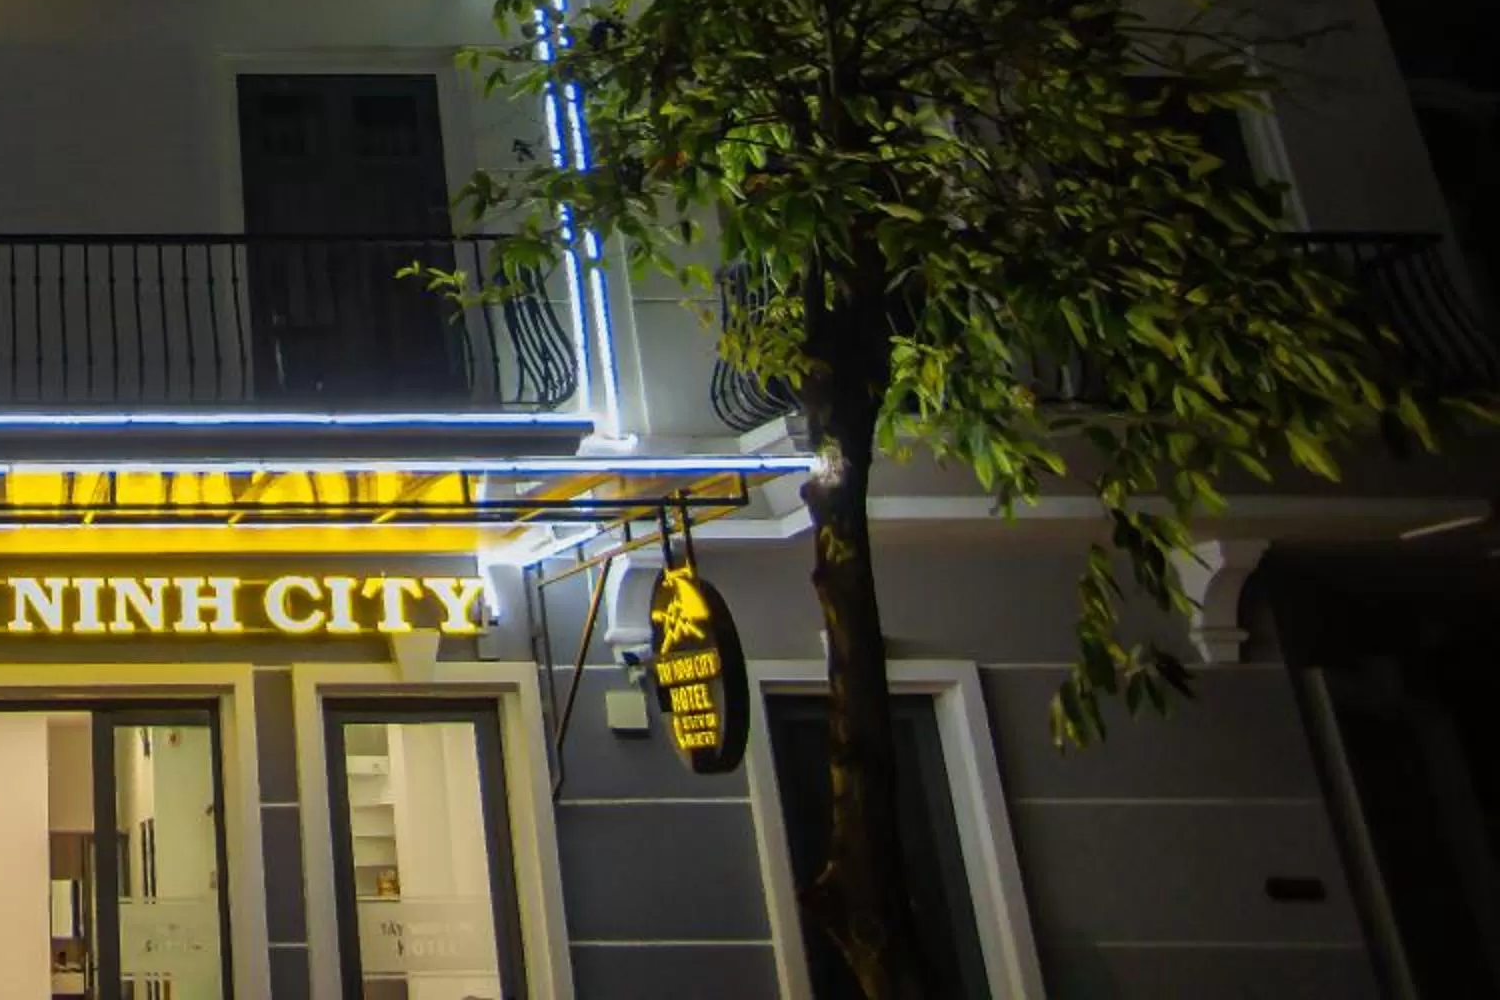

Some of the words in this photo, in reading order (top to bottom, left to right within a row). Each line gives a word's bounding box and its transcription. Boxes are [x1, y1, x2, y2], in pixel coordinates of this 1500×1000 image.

[7, 576, 245, 634] NINH
[263, 574, 485, 635] CITY
[669, 683, 713, 713] HOTEL
